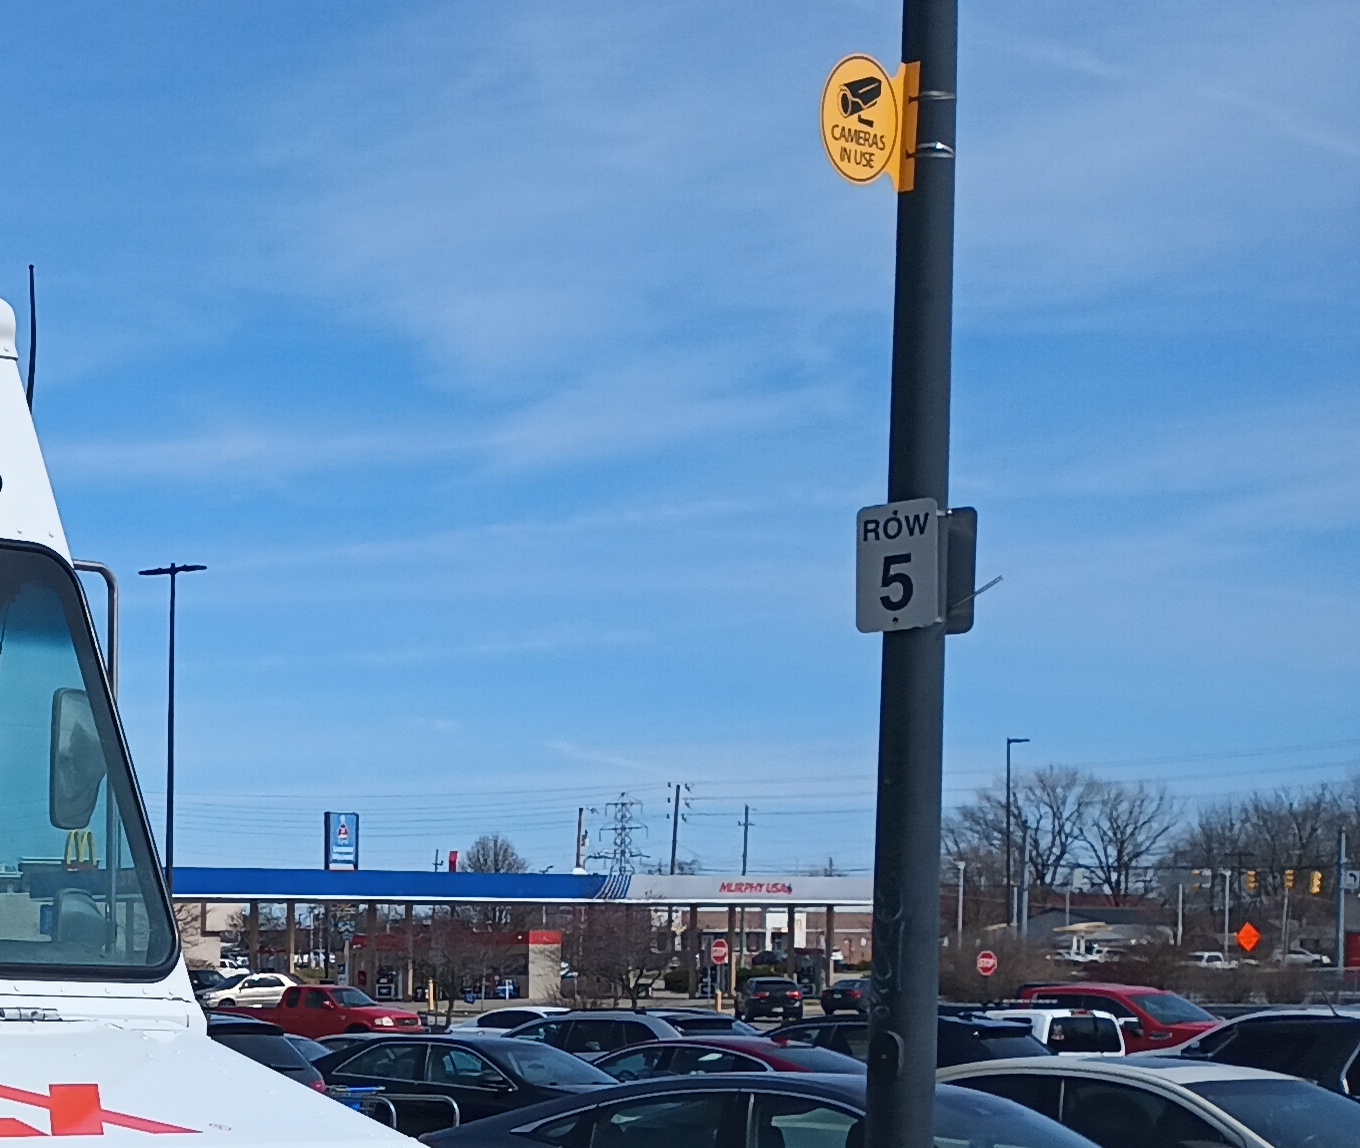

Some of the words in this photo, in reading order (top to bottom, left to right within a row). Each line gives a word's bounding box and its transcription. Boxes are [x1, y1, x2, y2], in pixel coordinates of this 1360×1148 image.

[831, 124, 886, 151] CAMERAS
[840, 146, 852, 163] IN
[854, 149, 876, 169] USE
[863, 512, 929, 541] ROW
[880, 552, 913, 611] 5
[719, 882, 764, 893] MURPHY
